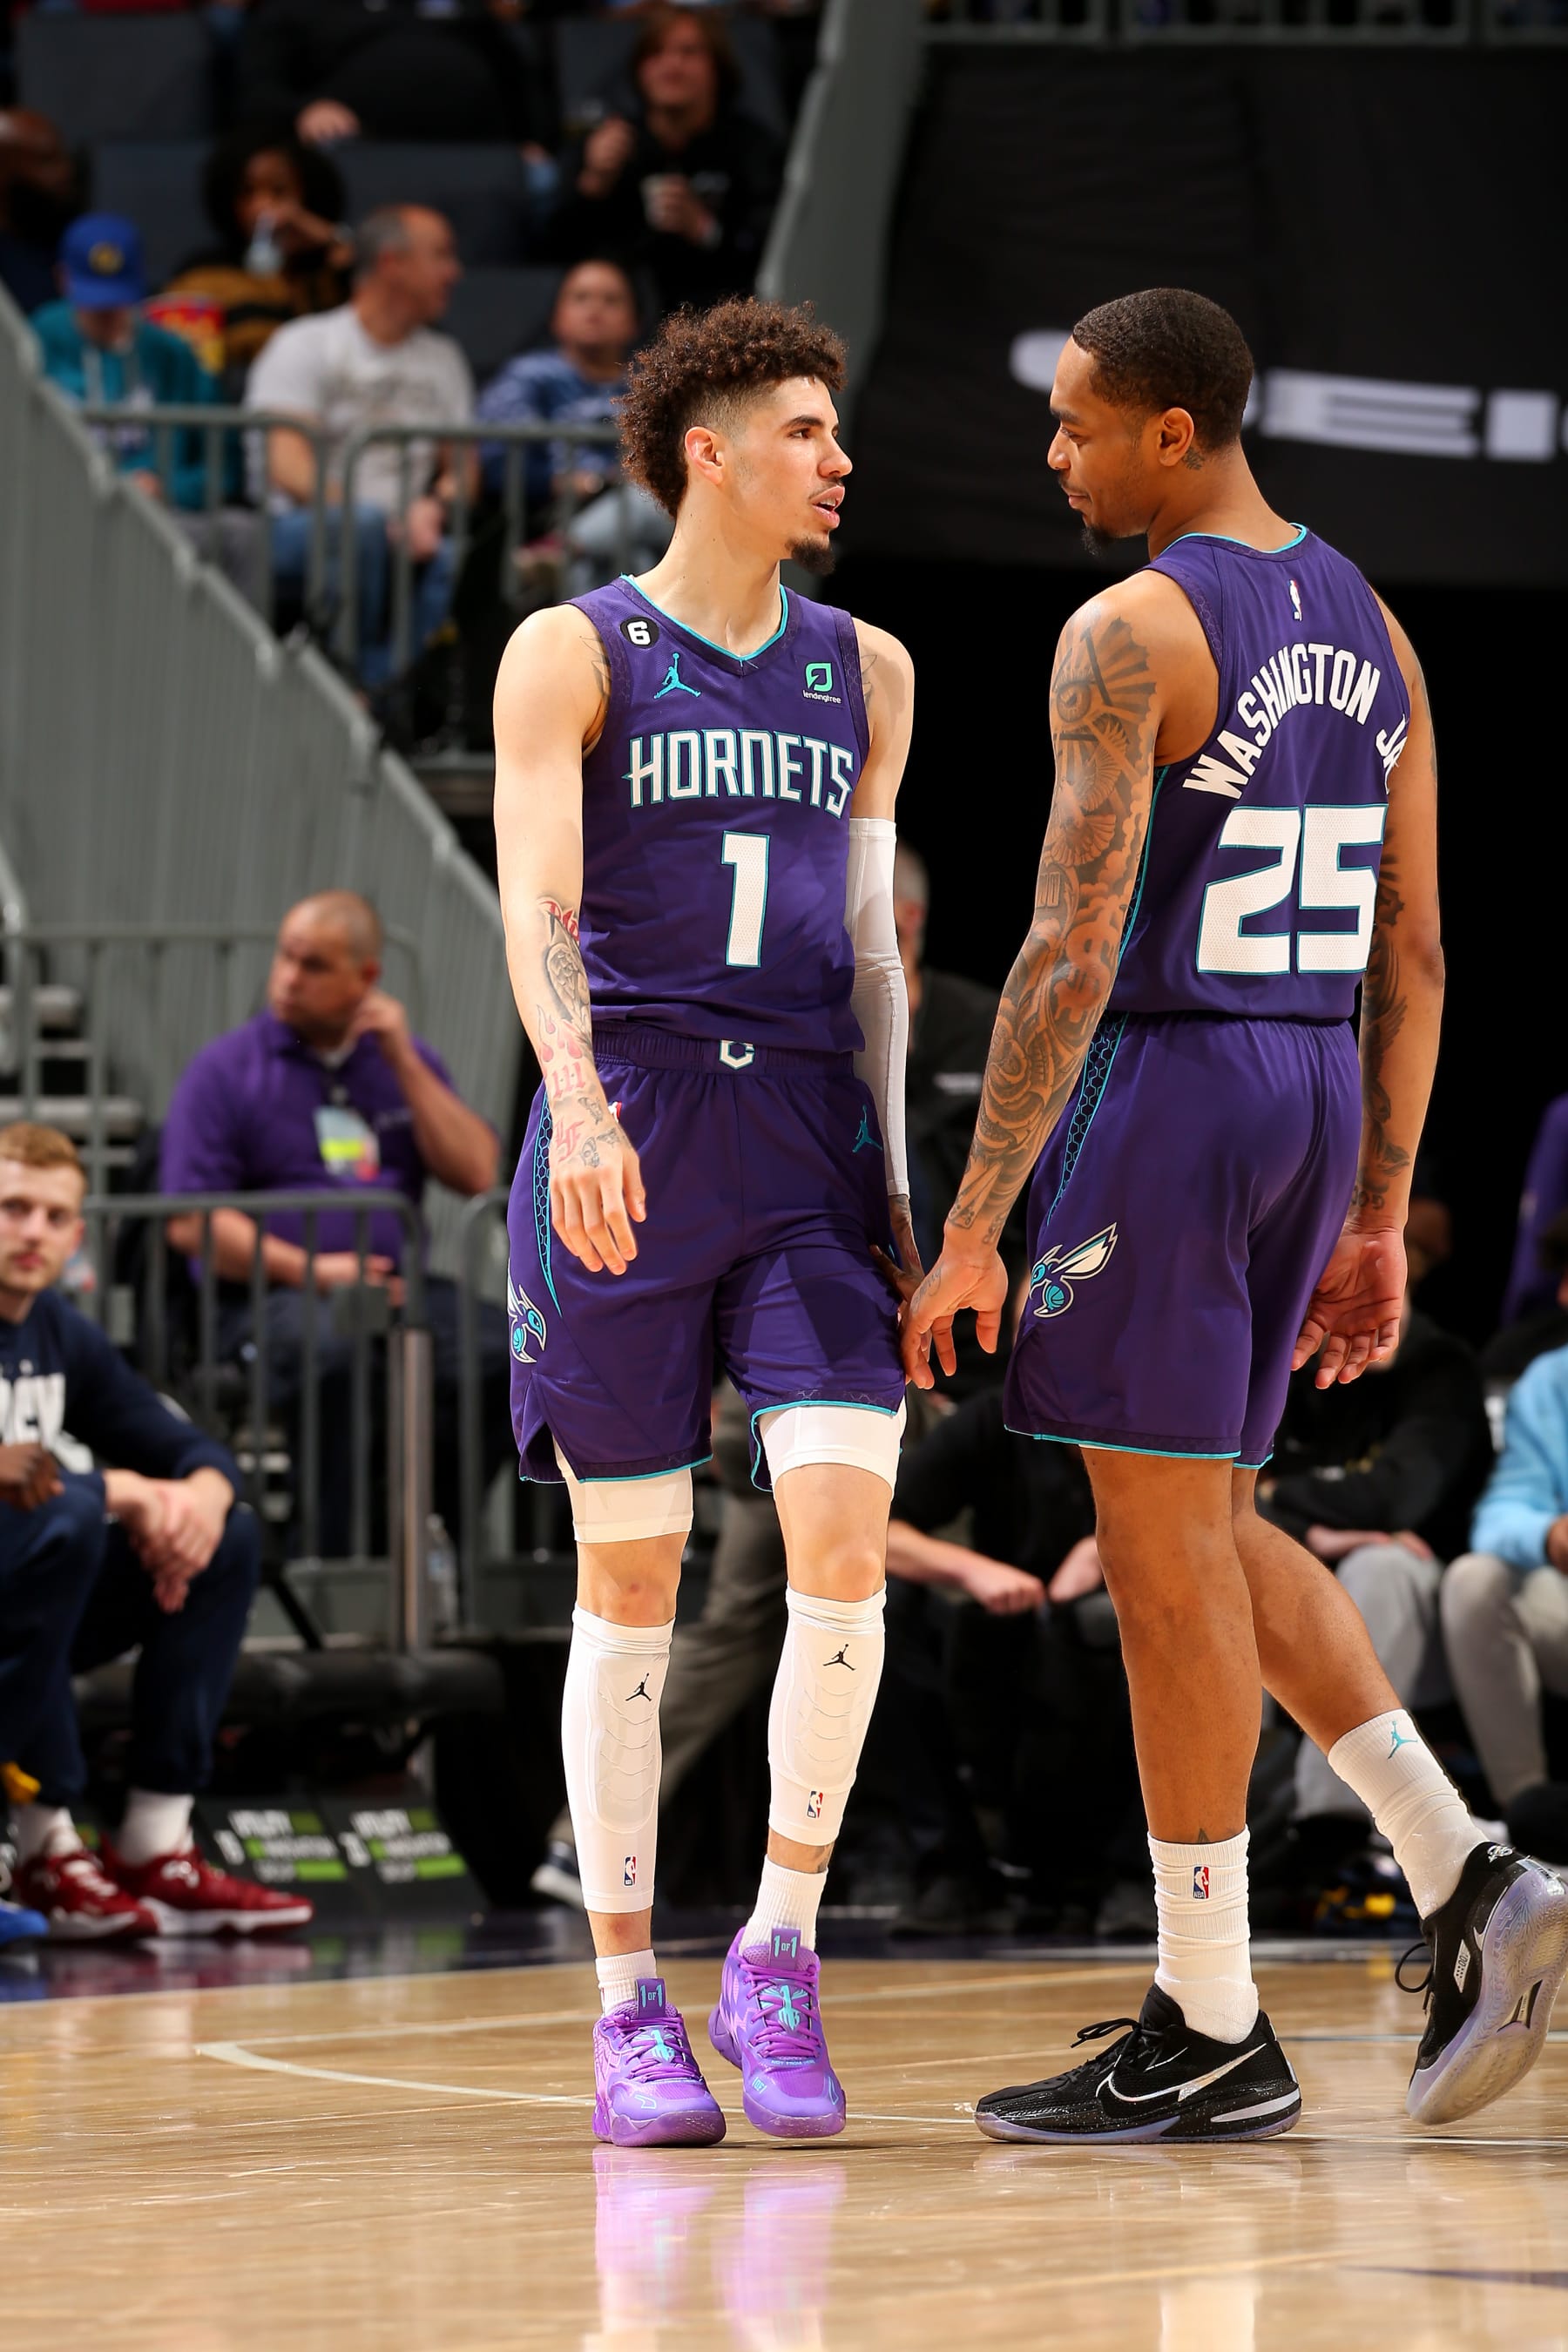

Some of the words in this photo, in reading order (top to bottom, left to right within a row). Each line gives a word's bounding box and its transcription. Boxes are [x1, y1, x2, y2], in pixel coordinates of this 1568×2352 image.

[627, 620, 651, 645] 6
[802, 690, 841, 704] lendingtree
[1182, 643, 1381, 800] WASHINGTON
[621, 728, 855, 819] HORNETS
[721, 830, 770, 968] 1
[1196, 803, 1389, 976] 25
[774, 1935, 781, 1957] 1
[791, 1936, 797, 1958] 1
[639, 1984, 646, 2008] 1
[656, 1984, 663, 2008] 1
